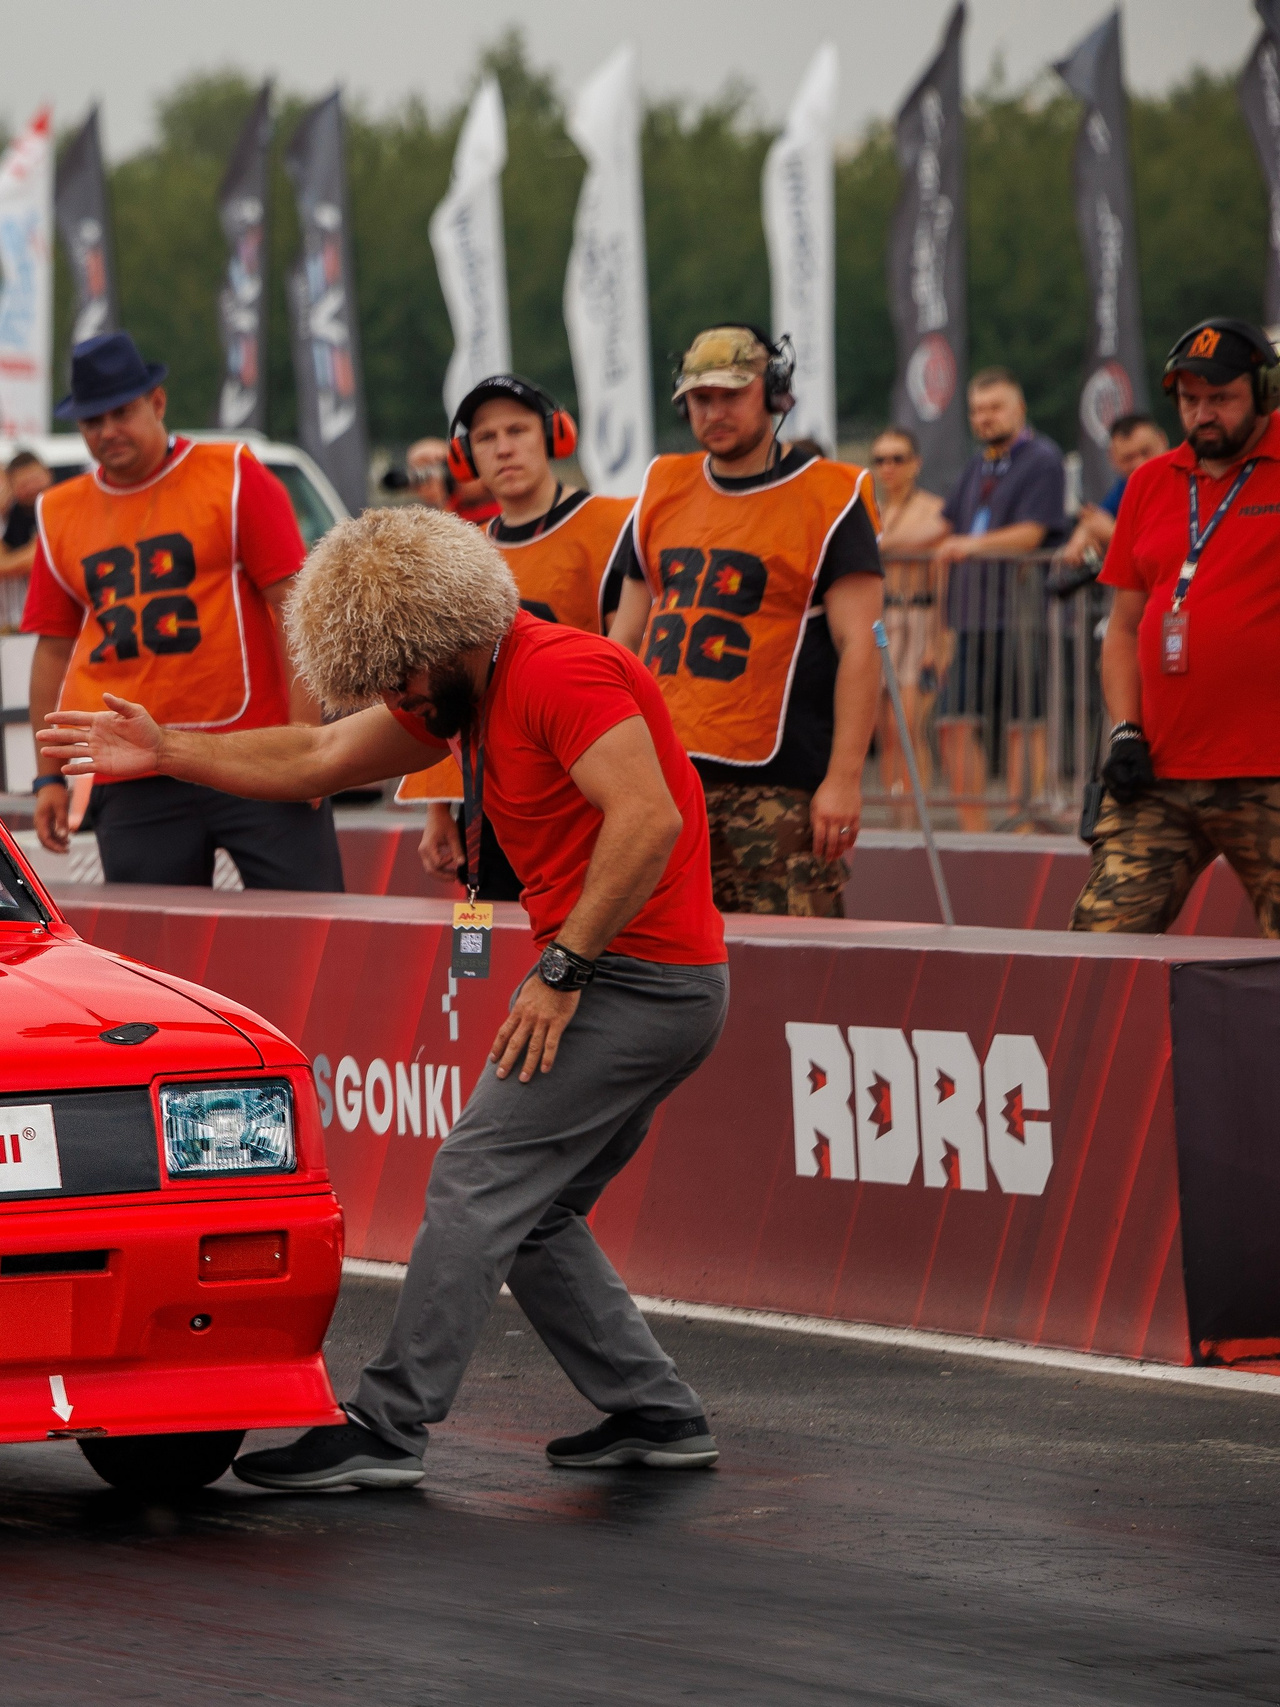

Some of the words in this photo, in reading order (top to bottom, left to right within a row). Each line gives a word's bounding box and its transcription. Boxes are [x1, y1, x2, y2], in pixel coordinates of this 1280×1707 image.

[81, 533, 196, 611] RD
[660, 547, 767, 617] RD
[89, 595, 202, 665] RC
[644, 613, 752, 683] RC
[785, 1021, 1054, 1196] RDRC
